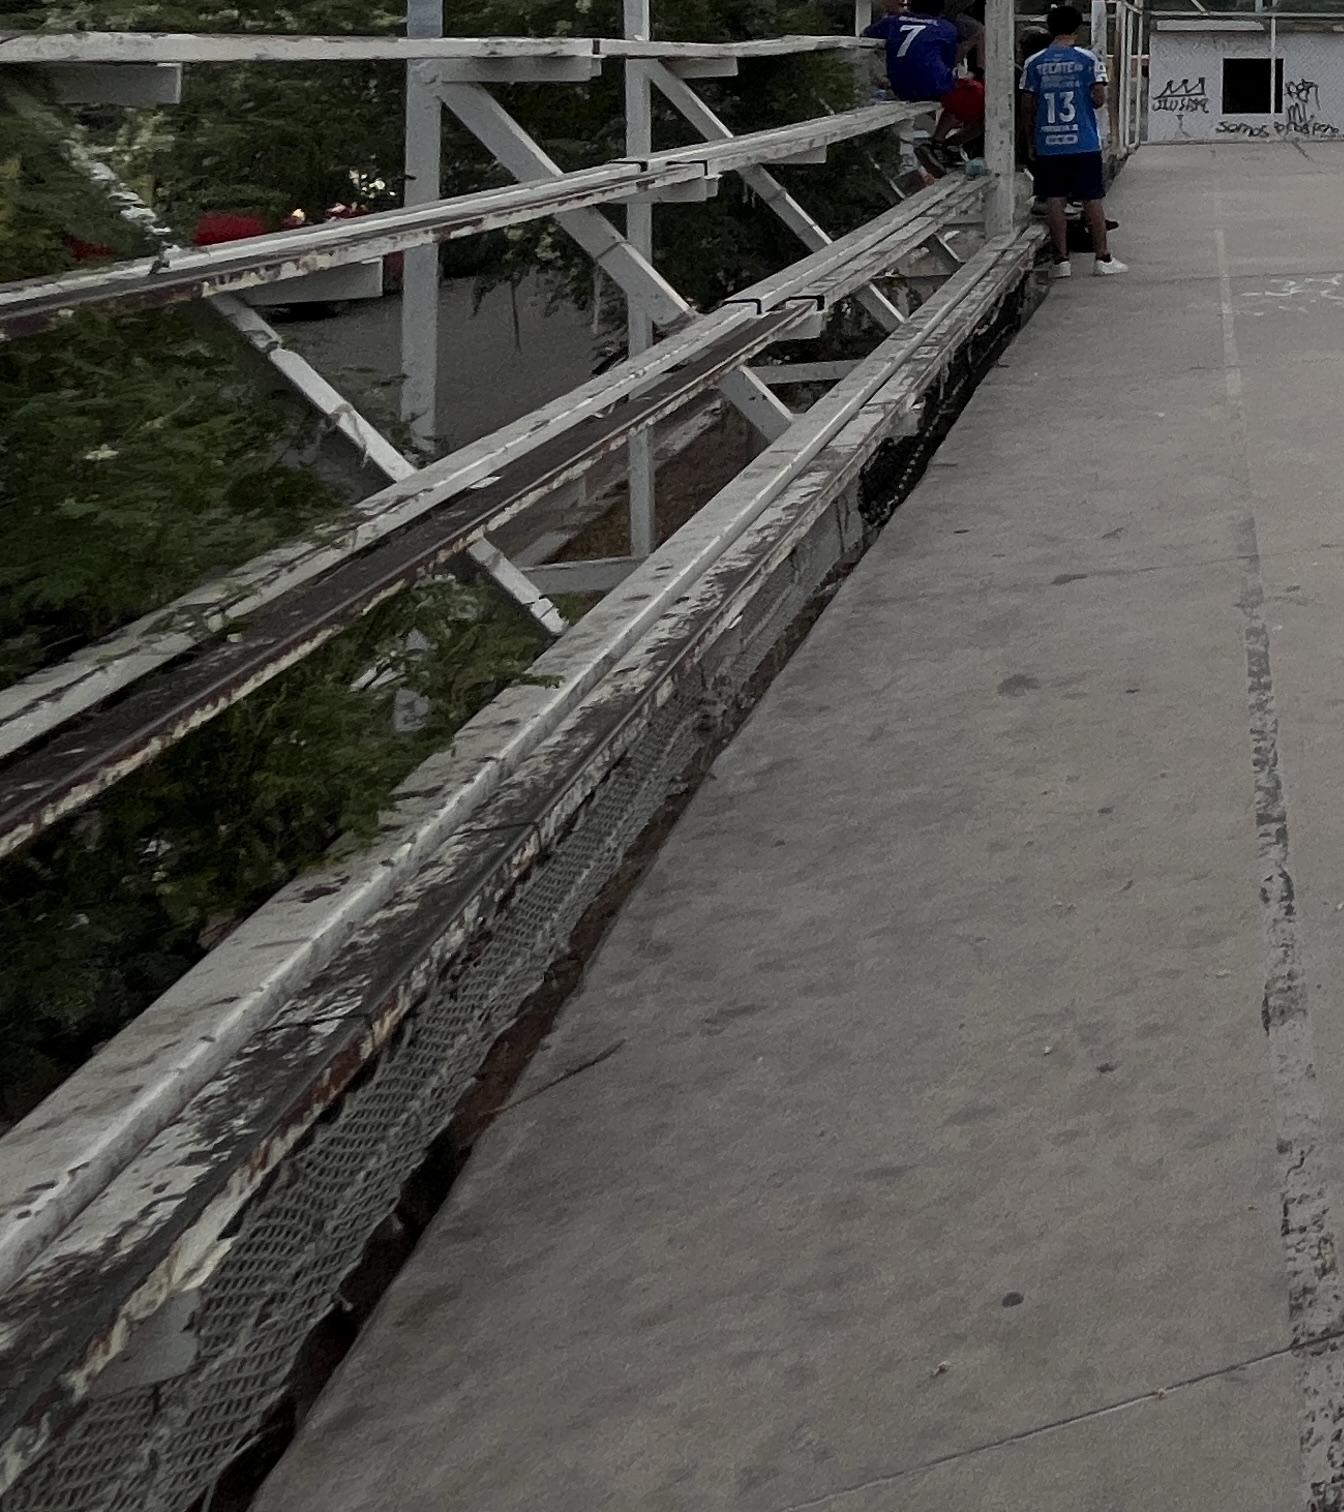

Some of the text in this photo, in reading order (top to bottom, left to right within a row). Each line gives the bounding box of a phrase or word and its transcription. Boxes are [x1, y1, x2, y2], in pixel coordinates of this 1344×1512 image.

[896, 24, 927, 58] 7
[1036, 61, 1076, 76] TECATE
[1043, 90, 1077, 124] 13
